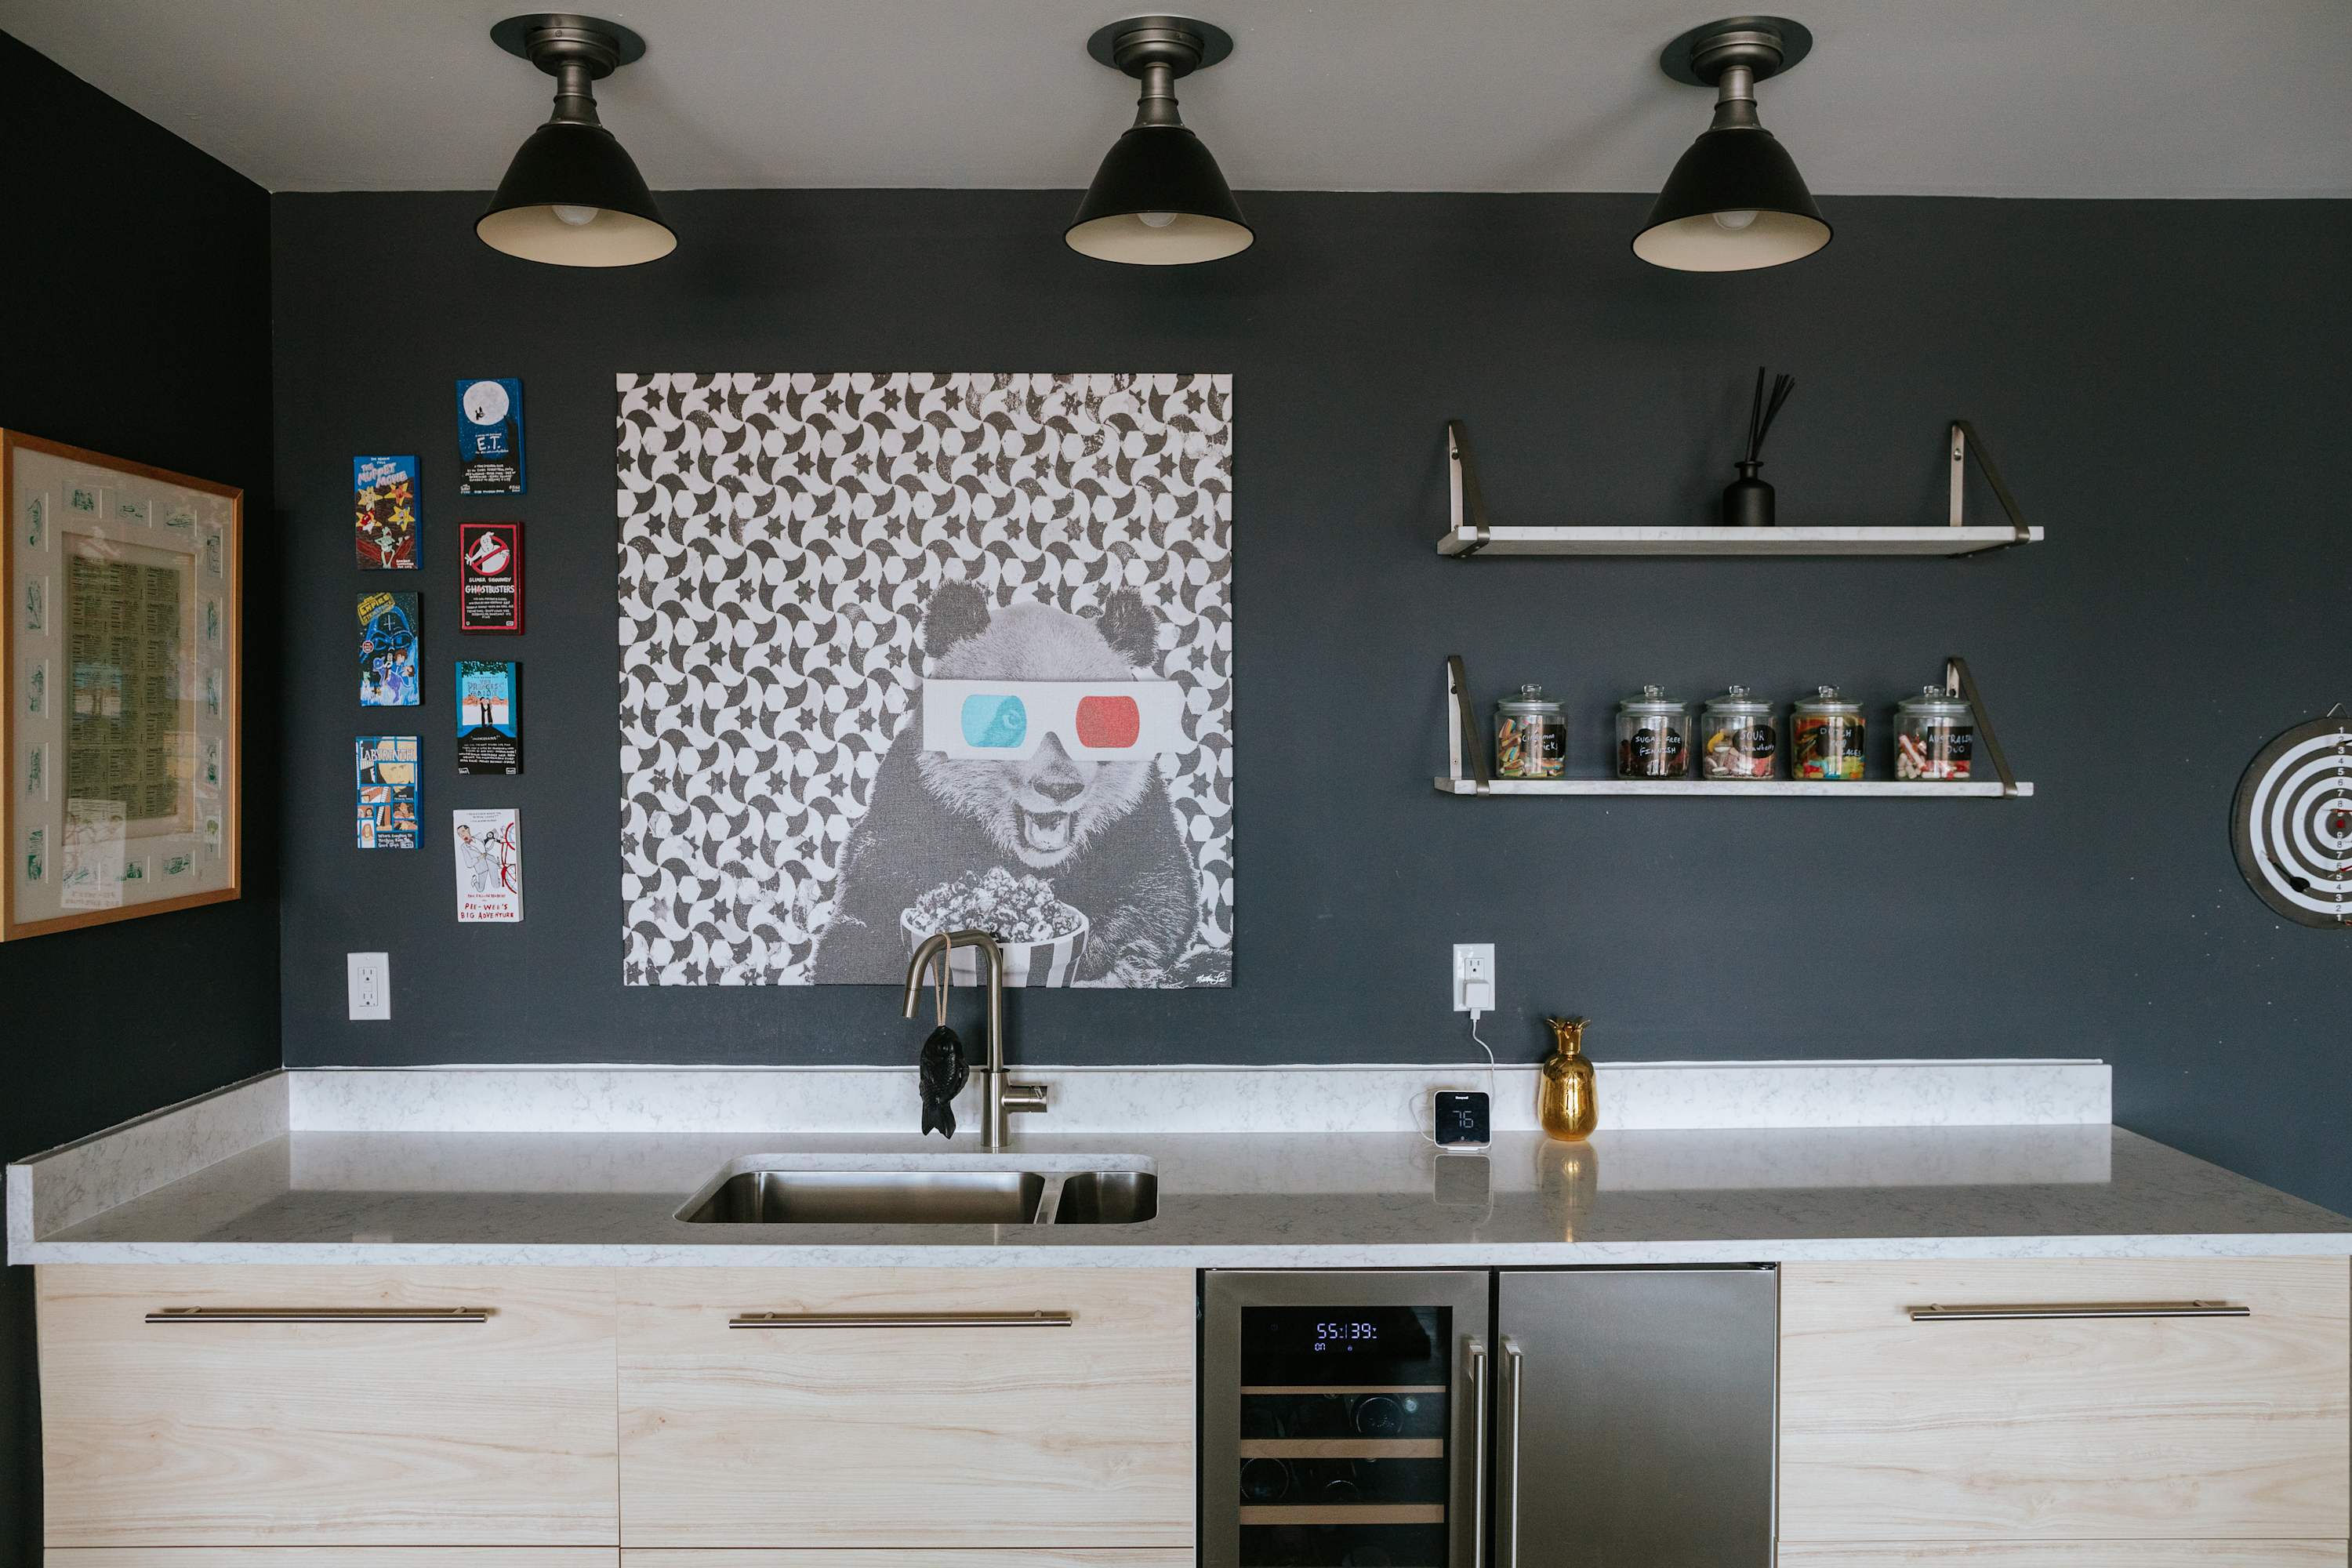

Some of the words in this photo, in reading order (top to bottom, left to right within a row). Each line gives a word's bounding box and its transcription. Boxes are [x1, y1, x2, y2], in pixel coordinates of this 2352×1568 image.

[477, 436, 502, 452] E.T.
[1739, 730, 1765, 741] SOUR
[359, 740, 415, 762] LABYRINTH
[2337, 746, 2345, 755] 3
[2337, 768, 2344, 776] 5
[2337, 789, 2344, 797] 7
[2336, 851, 2343, 859] 7
[2336, 893, 2343, 902] 3
[2336, 913, 2342, 922] 1
[1451, 1110, 1474, 1128] 76
